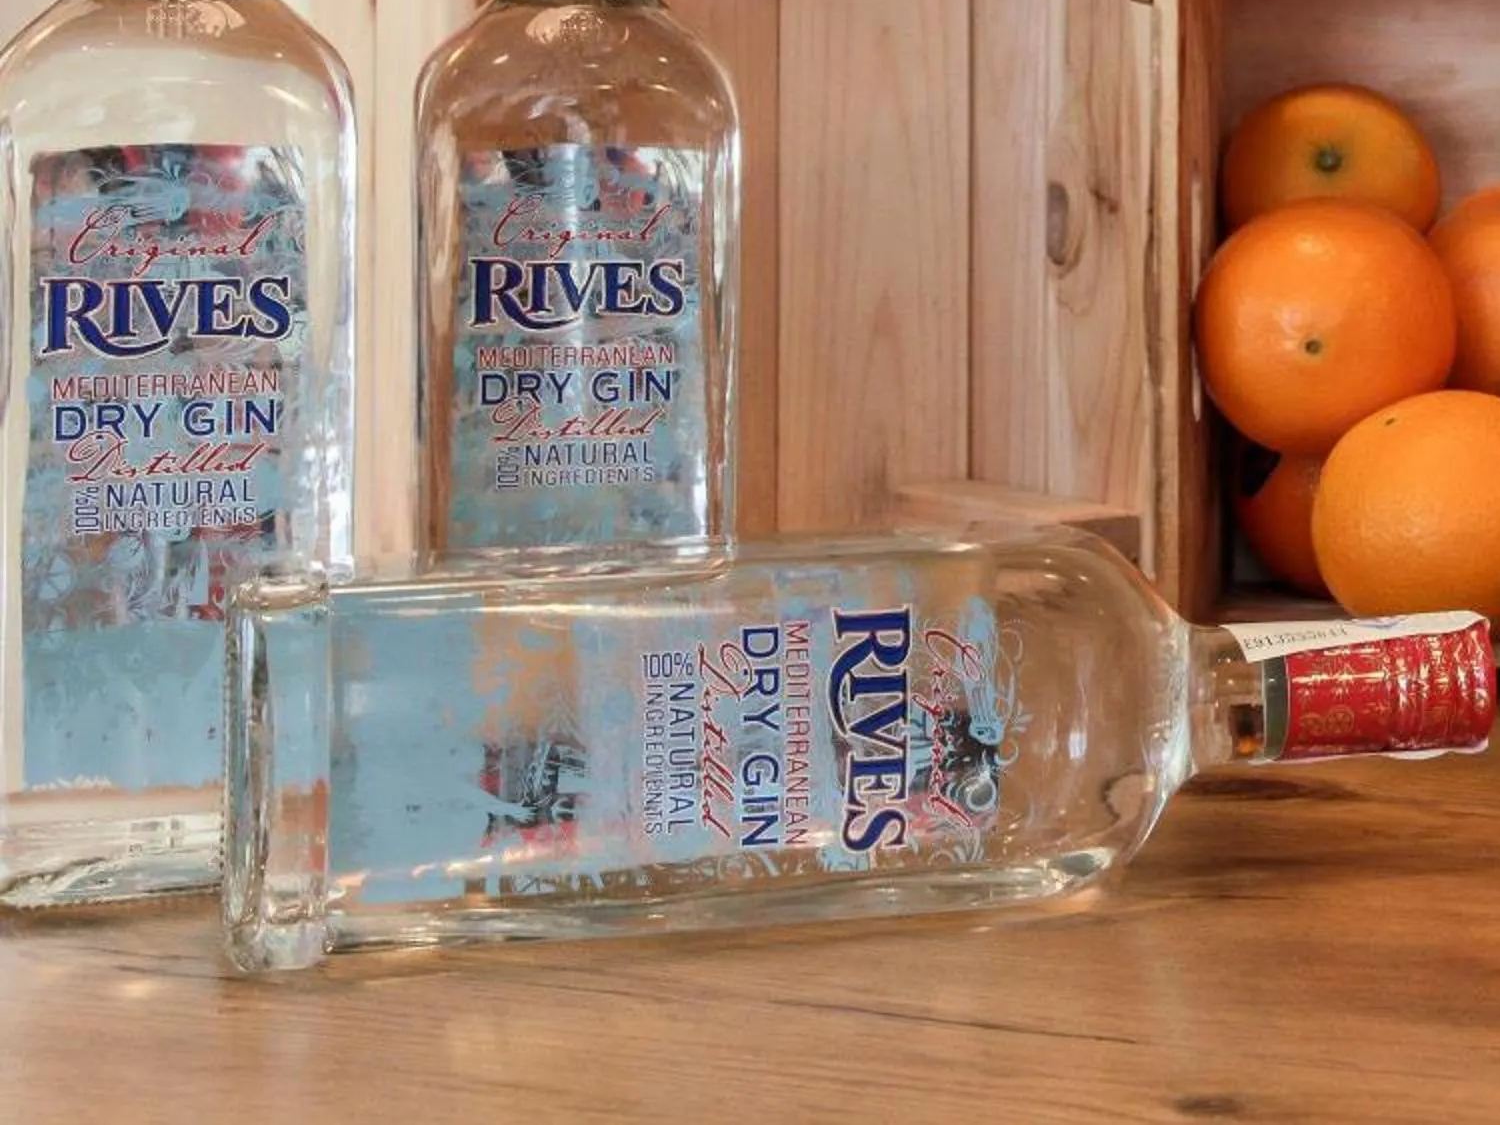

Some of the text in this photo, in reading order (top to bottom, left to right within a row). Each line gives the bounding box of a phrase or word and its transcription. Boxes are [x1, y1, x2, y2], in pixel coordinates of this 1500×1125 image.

[68, 204, 278, 277] Original
[494, 194, 671, 260] Original
[41, 275, 291, 357] RIVES
[469, 256, 684, 330] RIVES
[479, 344, 674, 368] MEDITERRANEAN
[53, 371, 280, 400] MEDITERRANEAN
[481, 371, 671, 405] DRY GIN
[54, 399, 277, 441] DRY GIN
[492, 396, 664, 442] Distilled
[67, 431, 272, 482] Distilled
[524, 443, 651, 466] NATURAL
[524, 467, 654, 486] INGREDIENTS
[74, 486, 100, 535] 100%
[104, 506, 256, 531] INGREDIENTS
[106, 479, 256, 508] NATURAL
[641, 652, 693, 678] 100%
[697, 643, 752, 837] Distilled
[742, 625, 779, 847] DRY GIN
[785, 620, 809, 845] MEDITERRANEAN
[829, 605, 912, 852] RIVES
[913, 629, 981, 827] Original
[645, 685, 665, 834] INGREDIENTS
[668, 683, 695, 834] NATURAL
